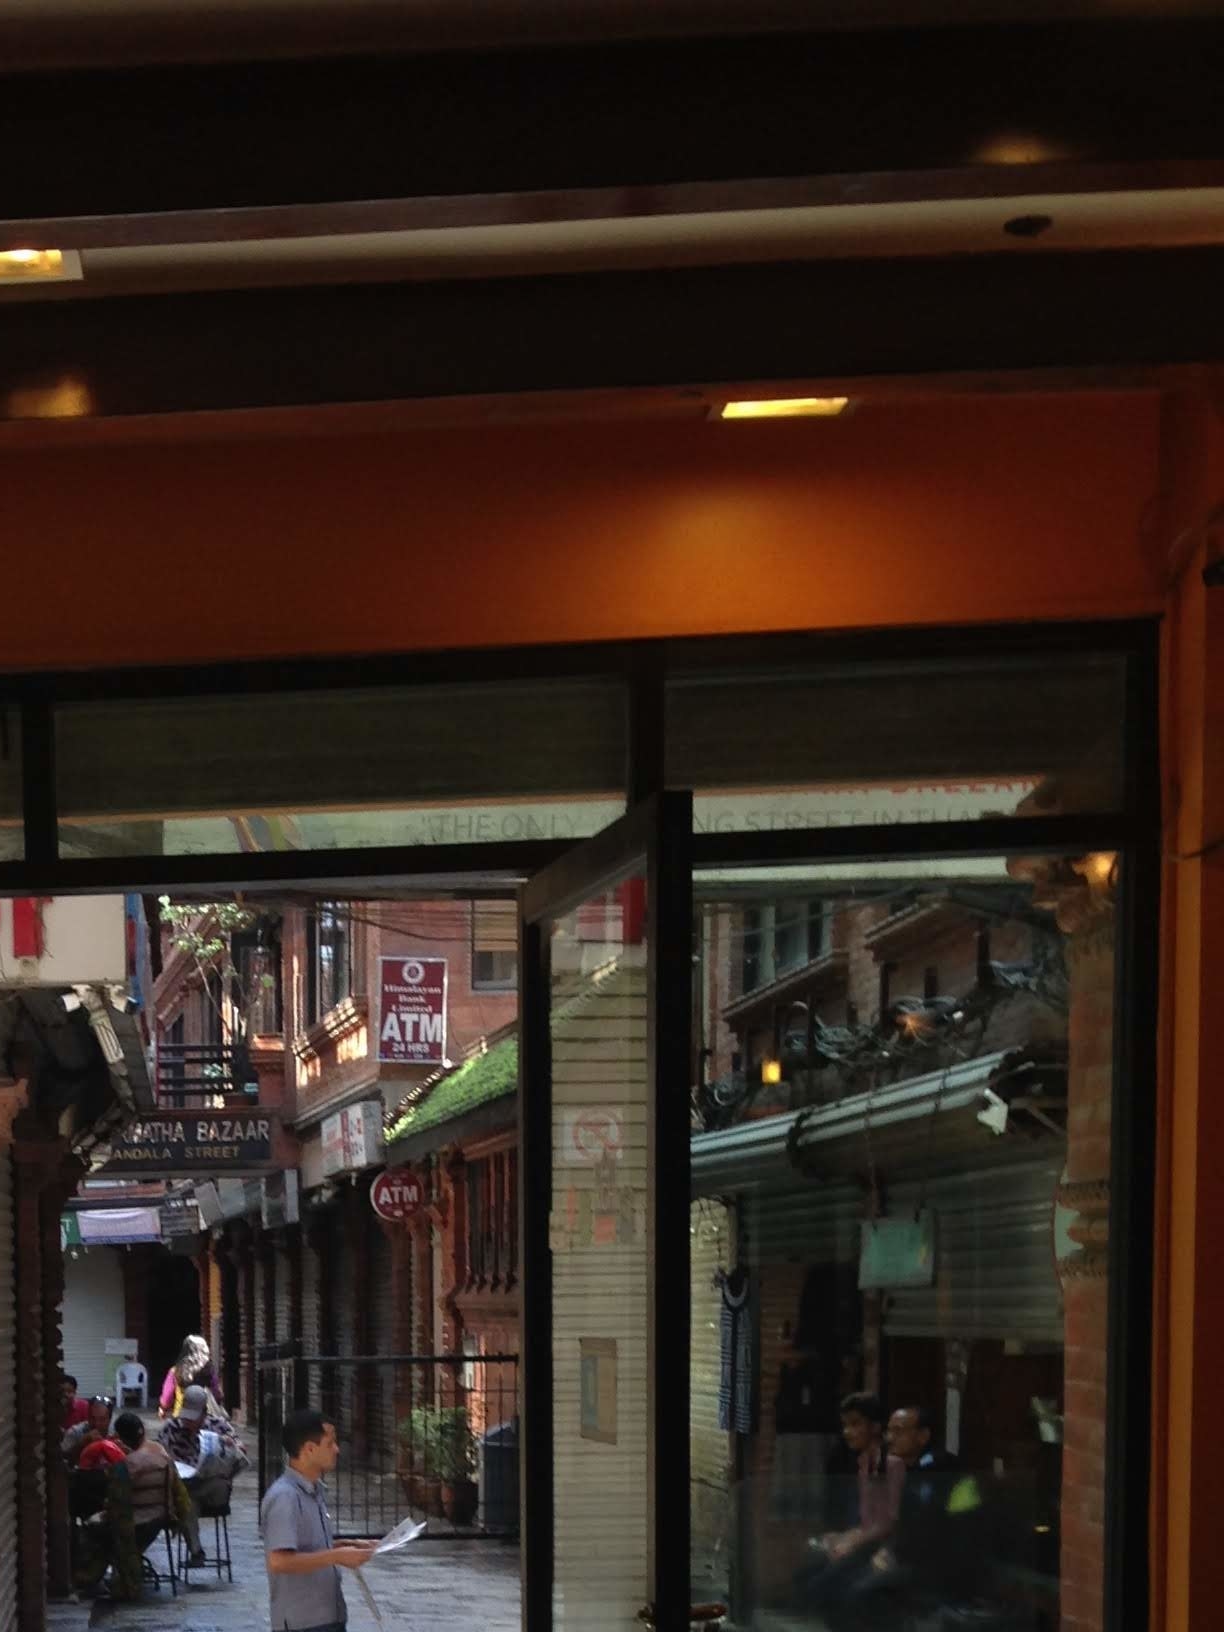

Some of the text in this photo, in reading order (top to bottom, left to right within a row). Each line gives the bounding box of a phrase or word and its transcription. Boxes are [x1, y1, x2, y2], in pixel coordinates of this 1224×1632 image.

[381, 1013, 442, 1042] ATM
[196, 1119, 270, 1142] BAZAAR
[112, 1146, 241, 1160] ANDALA STREET
[378, 1185, 419, 1206] ATM
